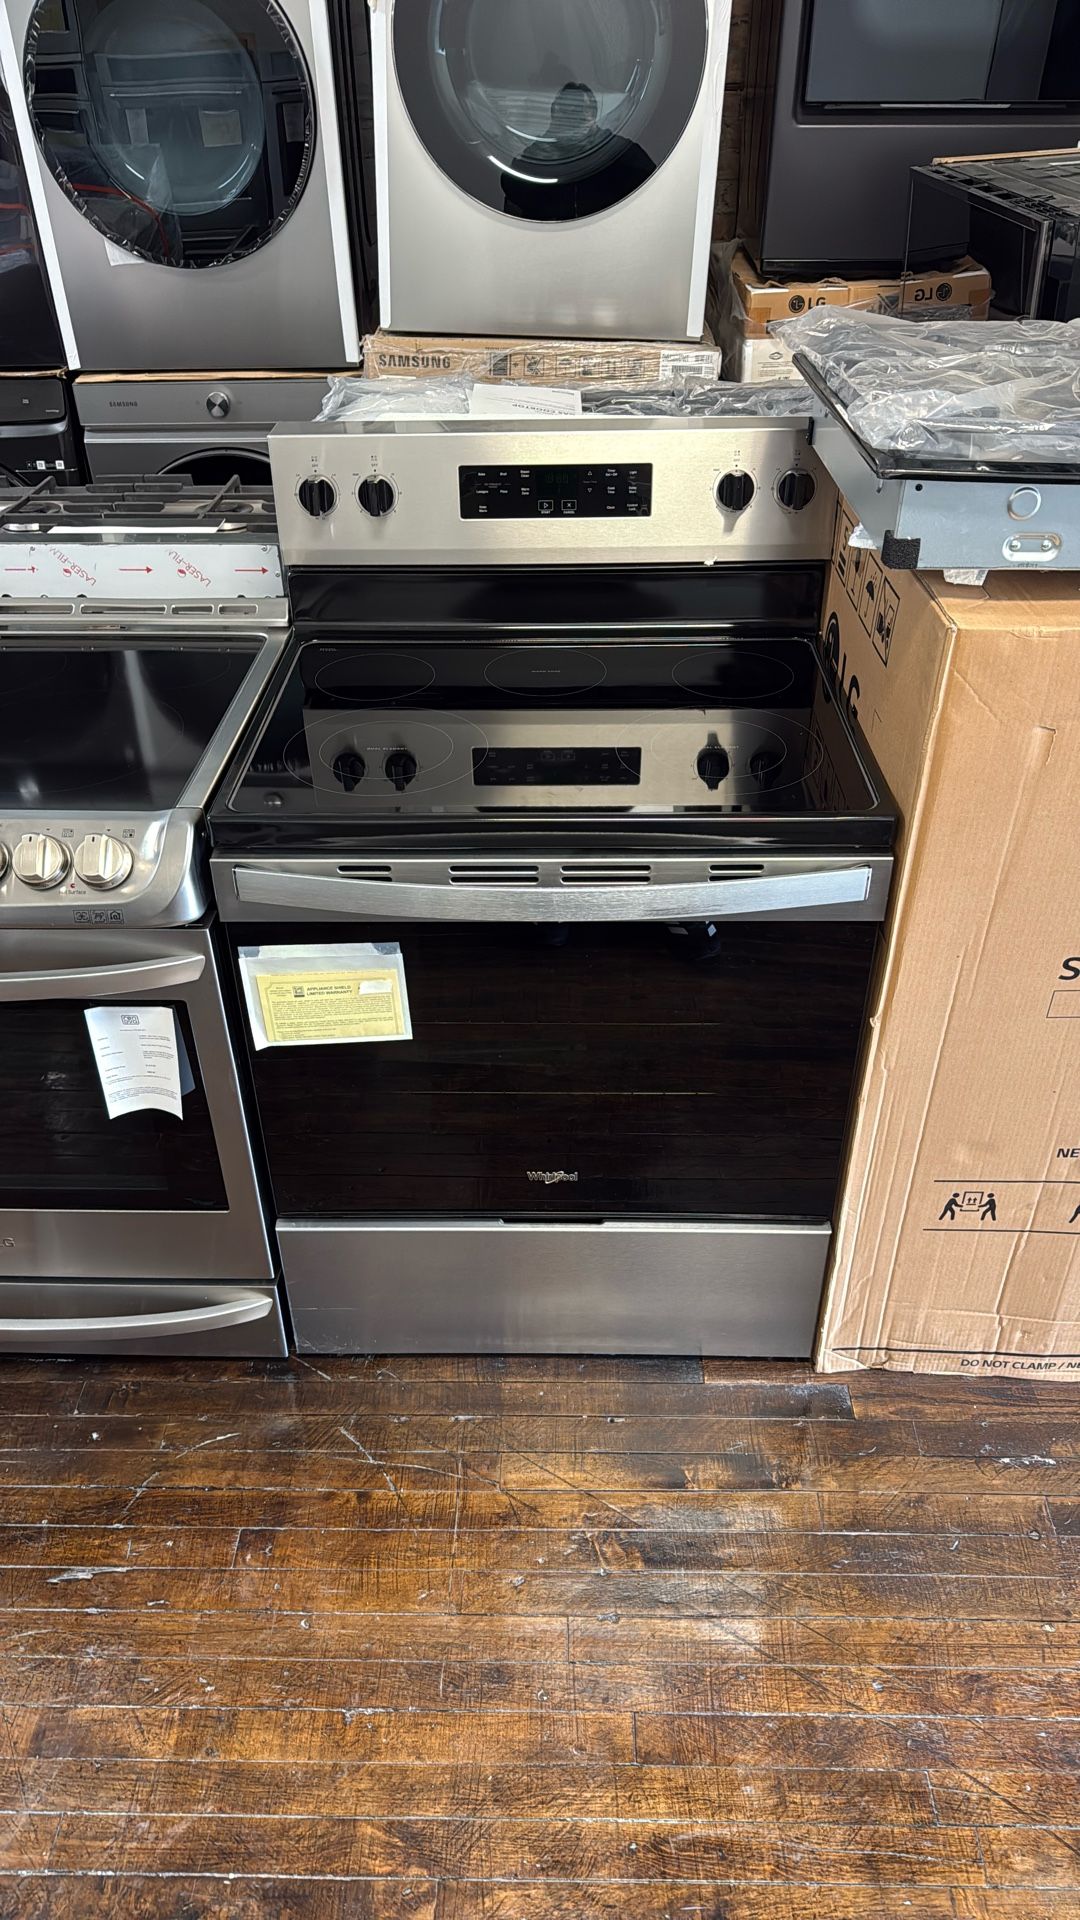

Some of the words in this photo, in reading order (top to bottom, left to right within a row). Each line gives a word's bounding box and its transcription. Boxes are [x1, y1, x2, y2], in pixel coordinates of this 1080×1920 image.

[378, 353, 451, 369] SAMSUNG
[526, 1170, 578, 1184] Whirlpool
[960, 1359, 980, 1367] DO
[982, 1360, 1011, 1369] NOT
[1012, 1361, 1057, 1370] CLAMP
